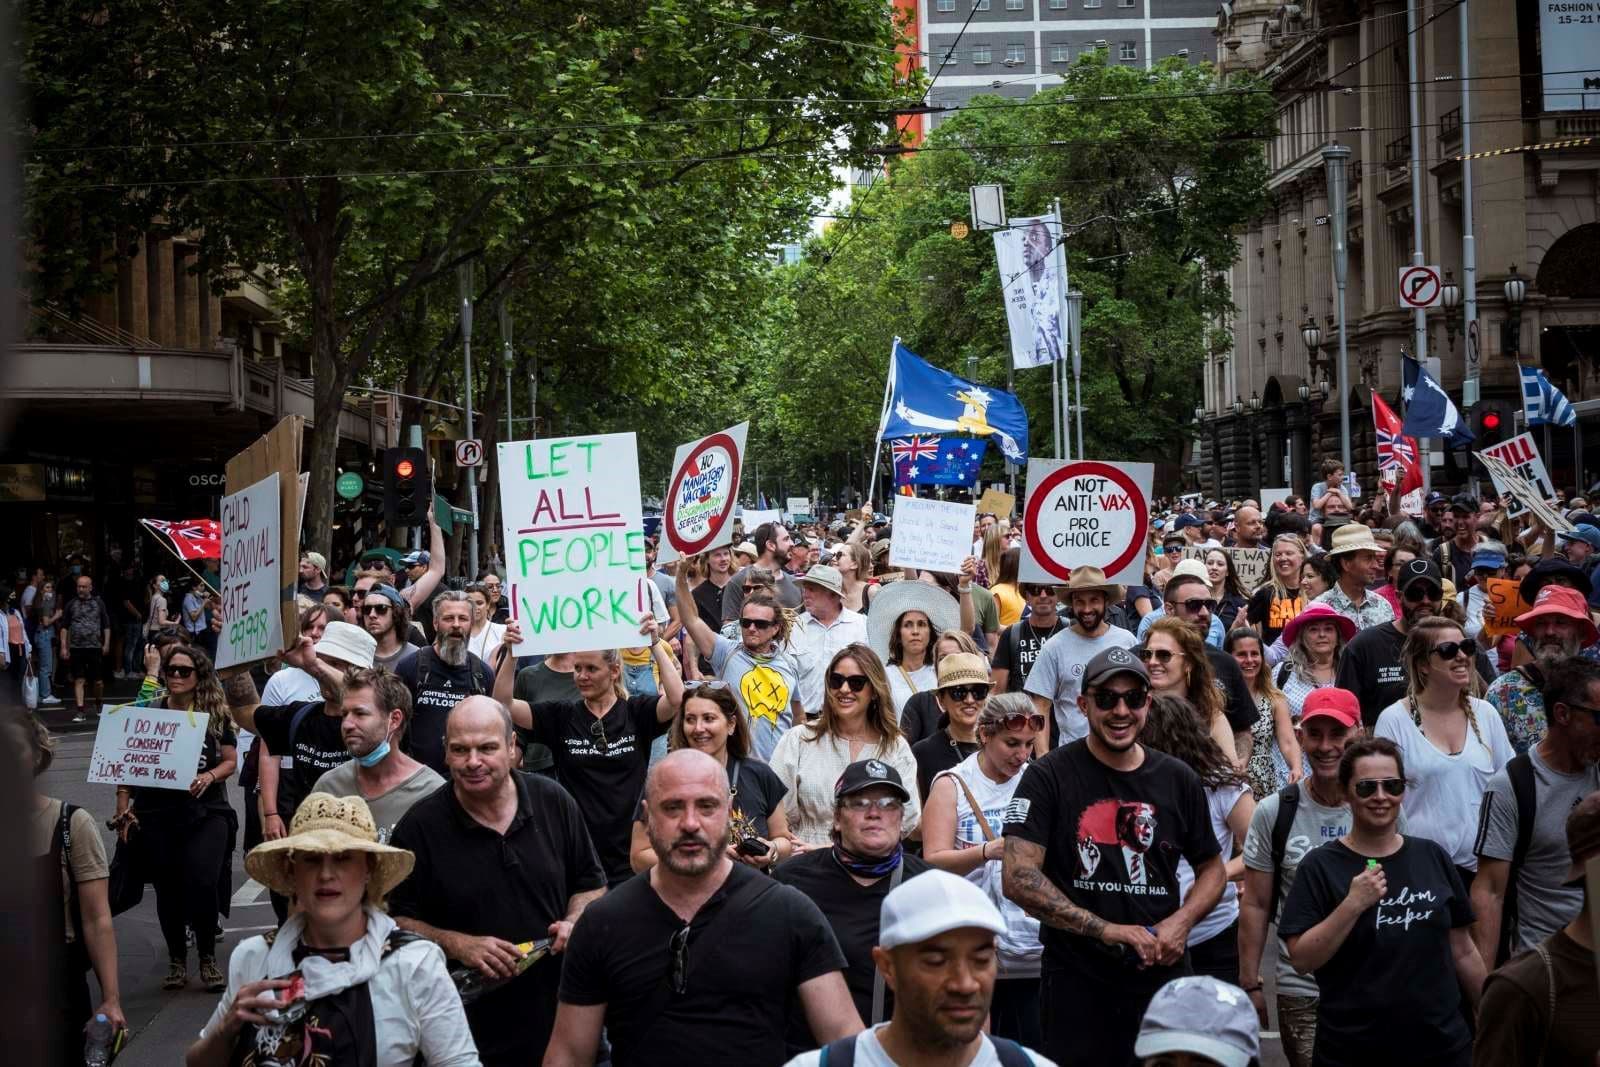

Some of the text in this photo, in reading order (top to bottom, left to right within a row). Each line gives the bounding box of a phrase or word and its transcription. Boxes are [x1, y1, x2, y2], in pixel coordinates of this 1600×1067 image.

[1548, 3, 1593, 12] FASHION
[526, 441, 602, 479] LET
[700, 454, 714, 471] NO
[682, 464, 726, 491] MANDATORY
[1074, 479, 1108, 492] NOT
[532, 487, 620, 524] ALL
[1054, 494, 1131, 511] ANTI-VAX
[222, 496, 249, 537] CHILD
[1069, 517, 1099, 530] PRO
[1052, 531, 1111, 547] CHOICE
[223, 527, 274, 582] SURVIVAL
[518, 531, 647, 577] PEOPLE
[1244, 549, 1271, 561] WAY
[222, 581, 250, 624] RATE
[124, 718, 180, 738] I DO NOT
[126, 737, 173, 752] CONSENT
[123, 753, 160, 764] CHOOSE
[153, 768, 177, 780] FEAR
[1073, 880, 1095, 891] BEST
[1098, 882, 1122, 892] YOU
[1149, 886, 1168, 895] HAD.
[1379, 886, 1437, 906] eedom
[1375, 907, 1433, 931] keeper
